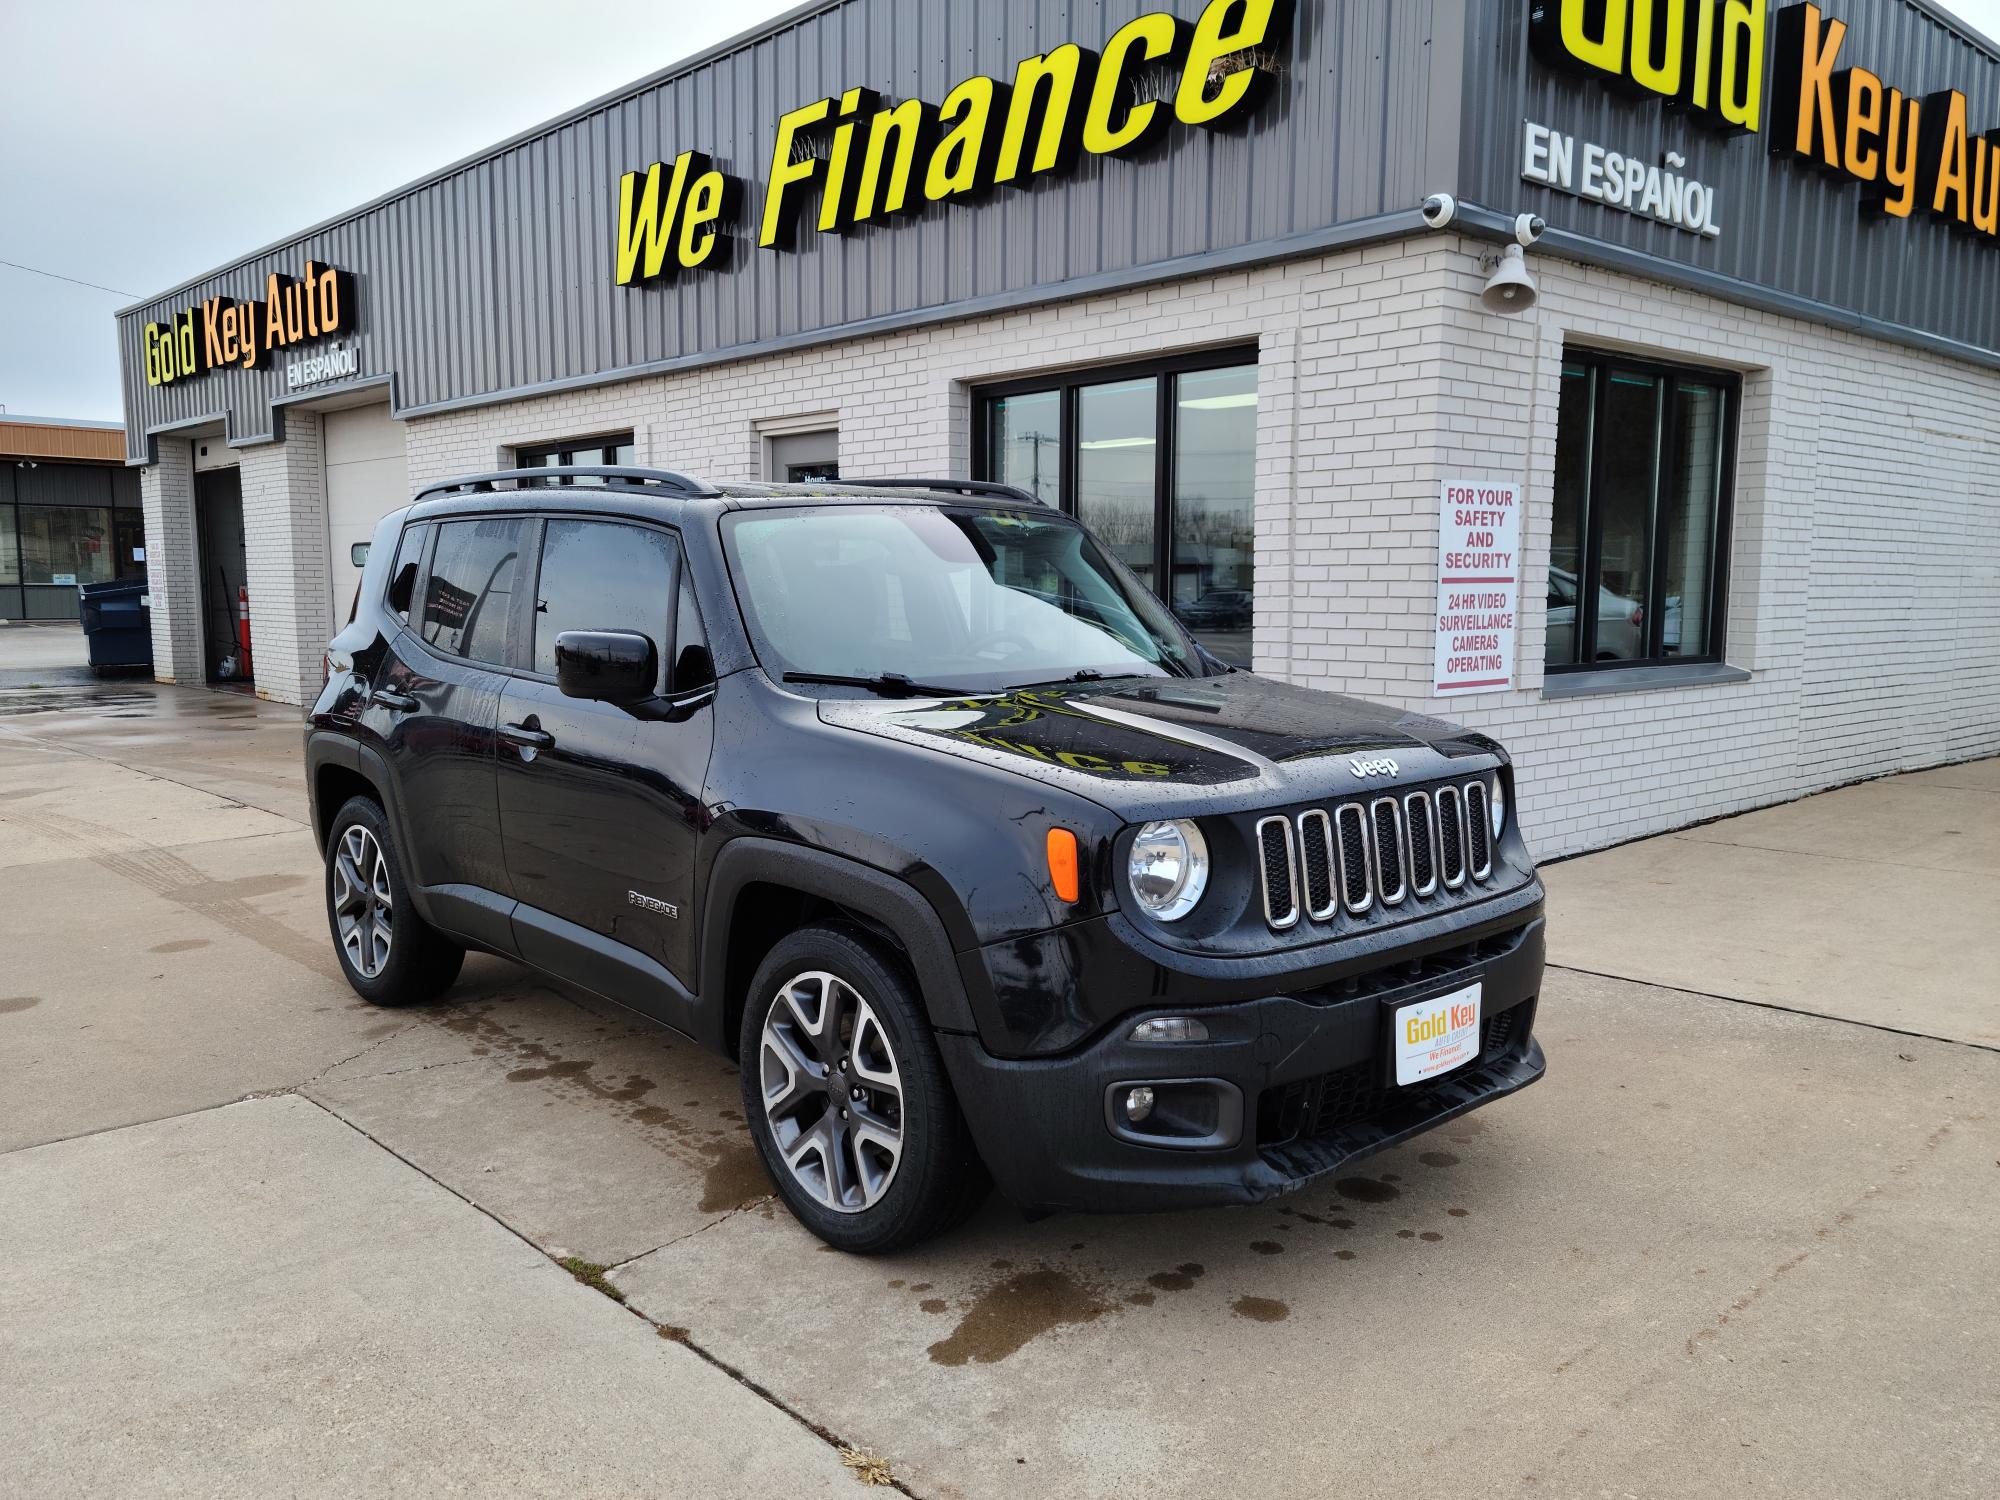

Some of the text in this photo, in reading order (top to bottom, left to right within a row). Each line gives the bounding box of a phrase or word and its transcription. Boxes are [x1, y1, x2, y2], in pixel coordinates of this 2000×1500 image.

[1796, 4, 1920, 218] Key
[616, 0, 1275, 287] We Finance
[1523, 122, 1720, 238] EN ESPAÑOL
[144, 260, 339, 387] Gold Key Auto
[287, 343, 359, 387] EN ESPAÑOL
[1447, 487, 1513, 506] FOR YOUR
[1455, 510, 1506, 527] SAFETY
[1466, 532, 1494, 548] AND
[1445, 552, 1512, 569] SECURITY
[1448, 592, 1507, 611] 24 HR VIDEO
[1439, 613, 1513, 632] SURVEILLANCE
[1452, 635, 1499, 652] CAMERAS
[1446, 655, 1502, 673] OPERATING
[1349, 758, 1399, 779] Jeep
[628, 890, 678, 919] RENEGADE
[1406, 1003, 1476, 1045] Gold Key
